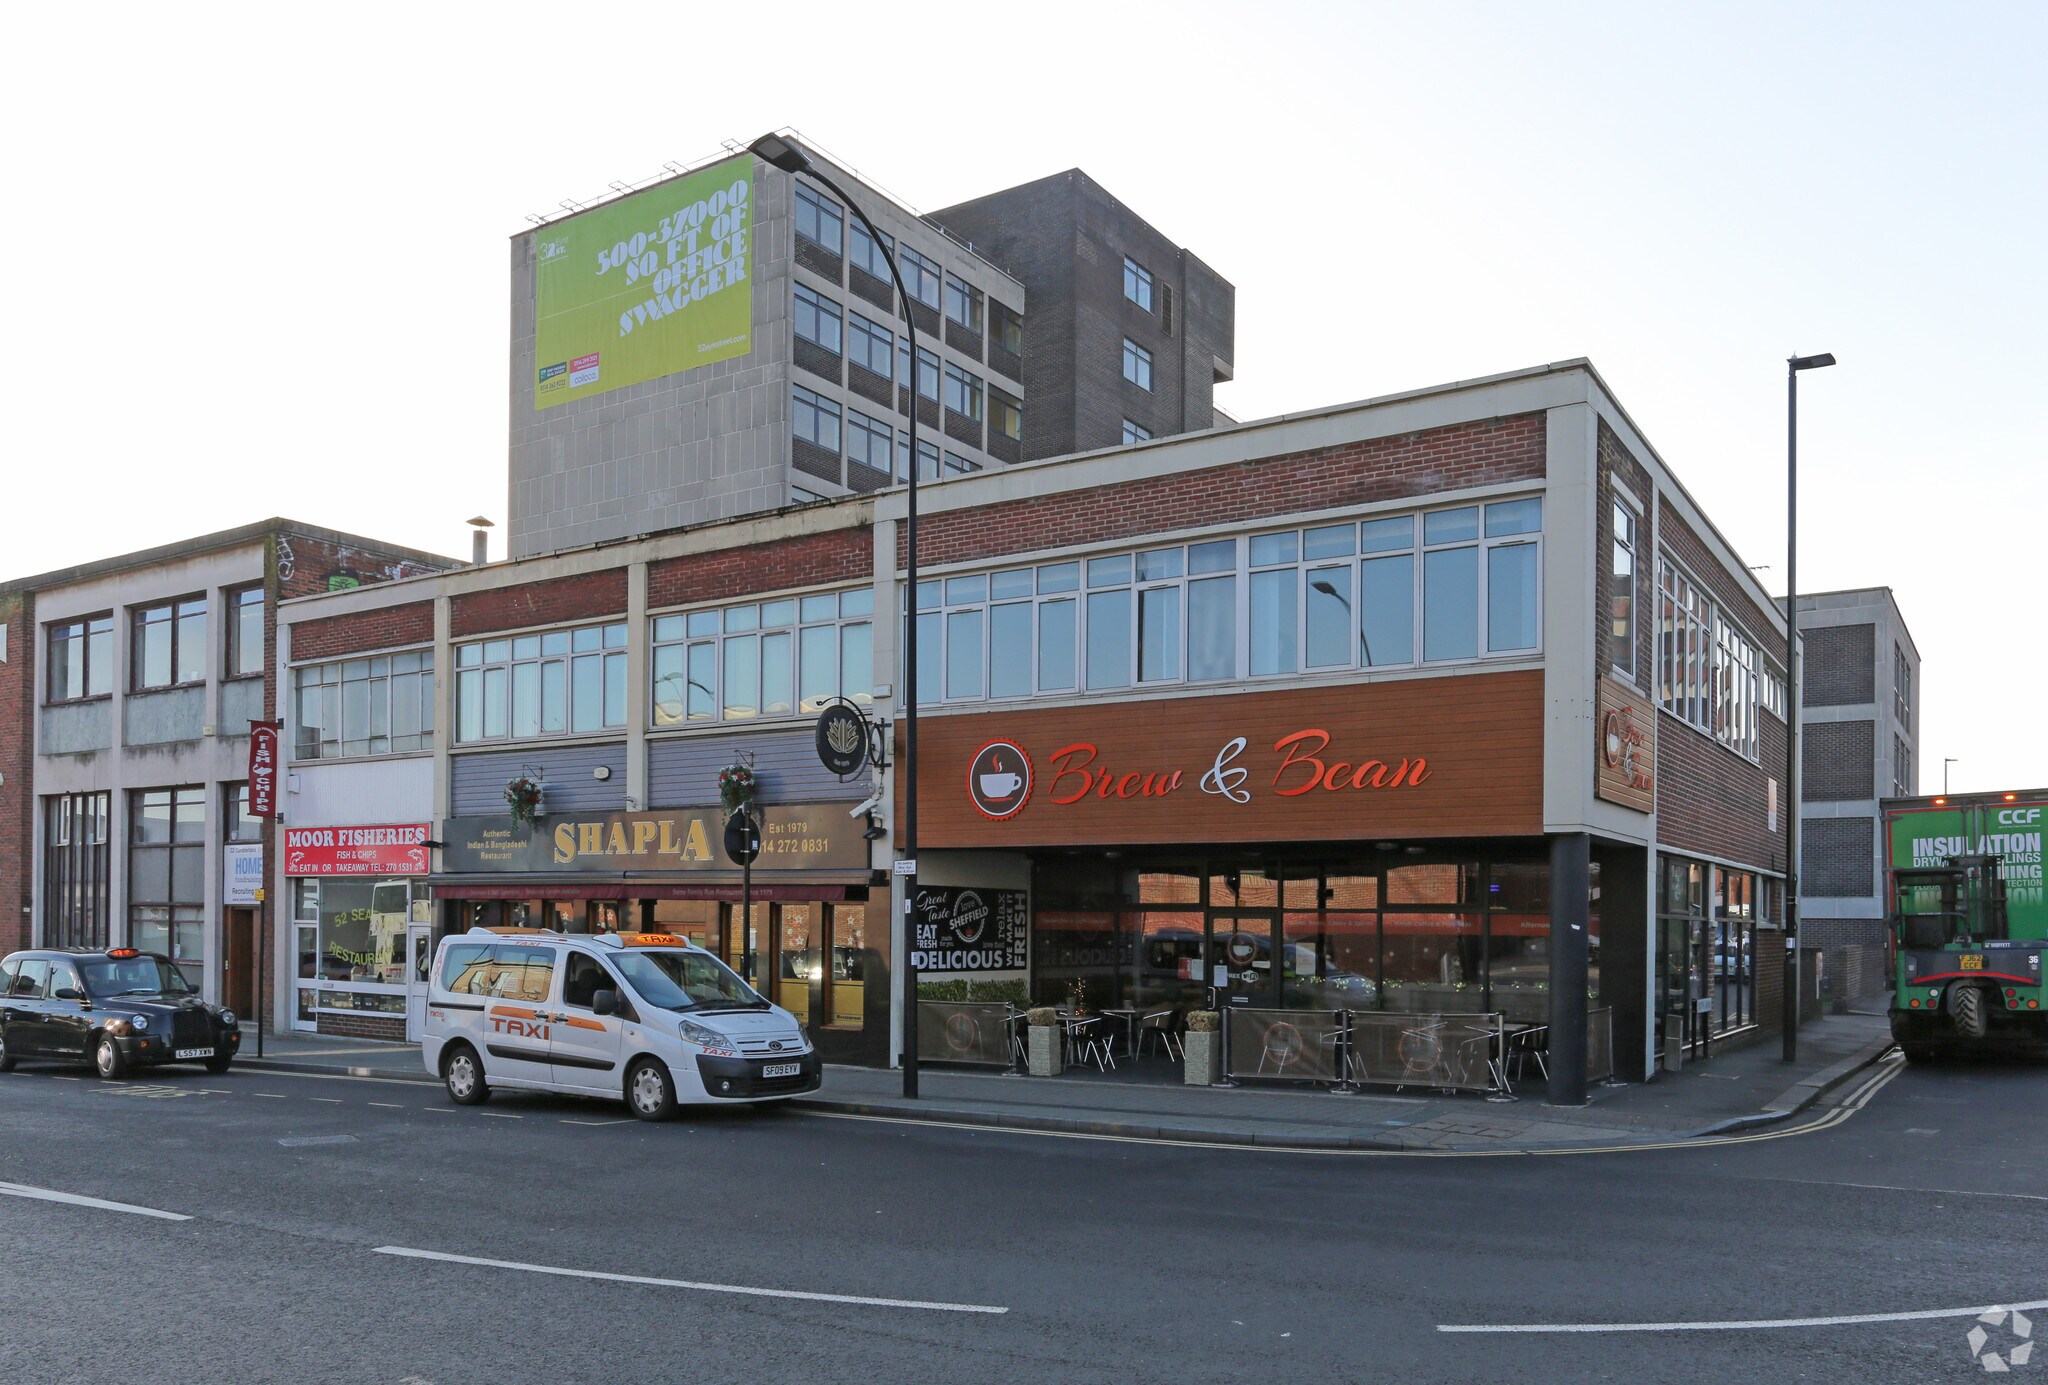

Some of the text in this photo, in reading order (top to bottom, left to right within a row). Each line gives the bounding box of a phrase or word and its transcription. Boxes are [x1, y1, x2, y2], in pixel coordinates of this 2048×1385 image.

[667, 225, 701, 265] FT
[711, 202, 747, 241] OF
[653, 229, 747, 294] OFFICE
[620, 256, 747, 337] SWAGGER
[256, 735, 270, 763] FISH
[1049, 728, 1433, 804] Brew & Bean
[256, 777, 270, 812] CHIPS
[1998, 809, 2040, 824] CCF
[288, 827, 426, 847] MOOR FISHERIES
[483, 830, 511, 838] Authentic
[769, 822, 808, 834] Est 1979
[467, 841, 485, 849] Indian
[491, 840, 527, 849] Bangladeshi
[554, 819, 714, 864] SHAPLA
[777, 839, 798, 853] 272
[801, 838, 828, 852] 0831
[1912, 833, 2042, 857] INSULATION
[337, 850, 377, 859] FISH & CHIPS
[480, 852, 512, 860] Restaurant
[236, 857, 262, 874] HOME
[299, 863, 413, 872] EAT IN OR TAKEAWAY TEL: 270 1531
[916, 891, 947, 911] Great
[1006, 893, 1012, 906] IT
[335, 912, 348, 928] 52
[925, 905, 951, 922] Taste
[949, 906, 989, 930] SHEFFIELD
[996, 893, 1005, 939] relax
[916, 924, 937, 939] EAT
[1014, 893, 1026, 967] FRESH
[433, 943, 447, 987] TAXI
[916, 950, 1003, 969] DELICIOUS
[1006, 947, 1012, 966] WE
[1963, 961, 1978, 969] CCF
[2028, 955, 2038, 964] 36
[489, 1017, 549, 1041] TAXI
[702, 1046, 733, 1057] TAXI
[765, 1065, 798, 1076] SF09 EYV
